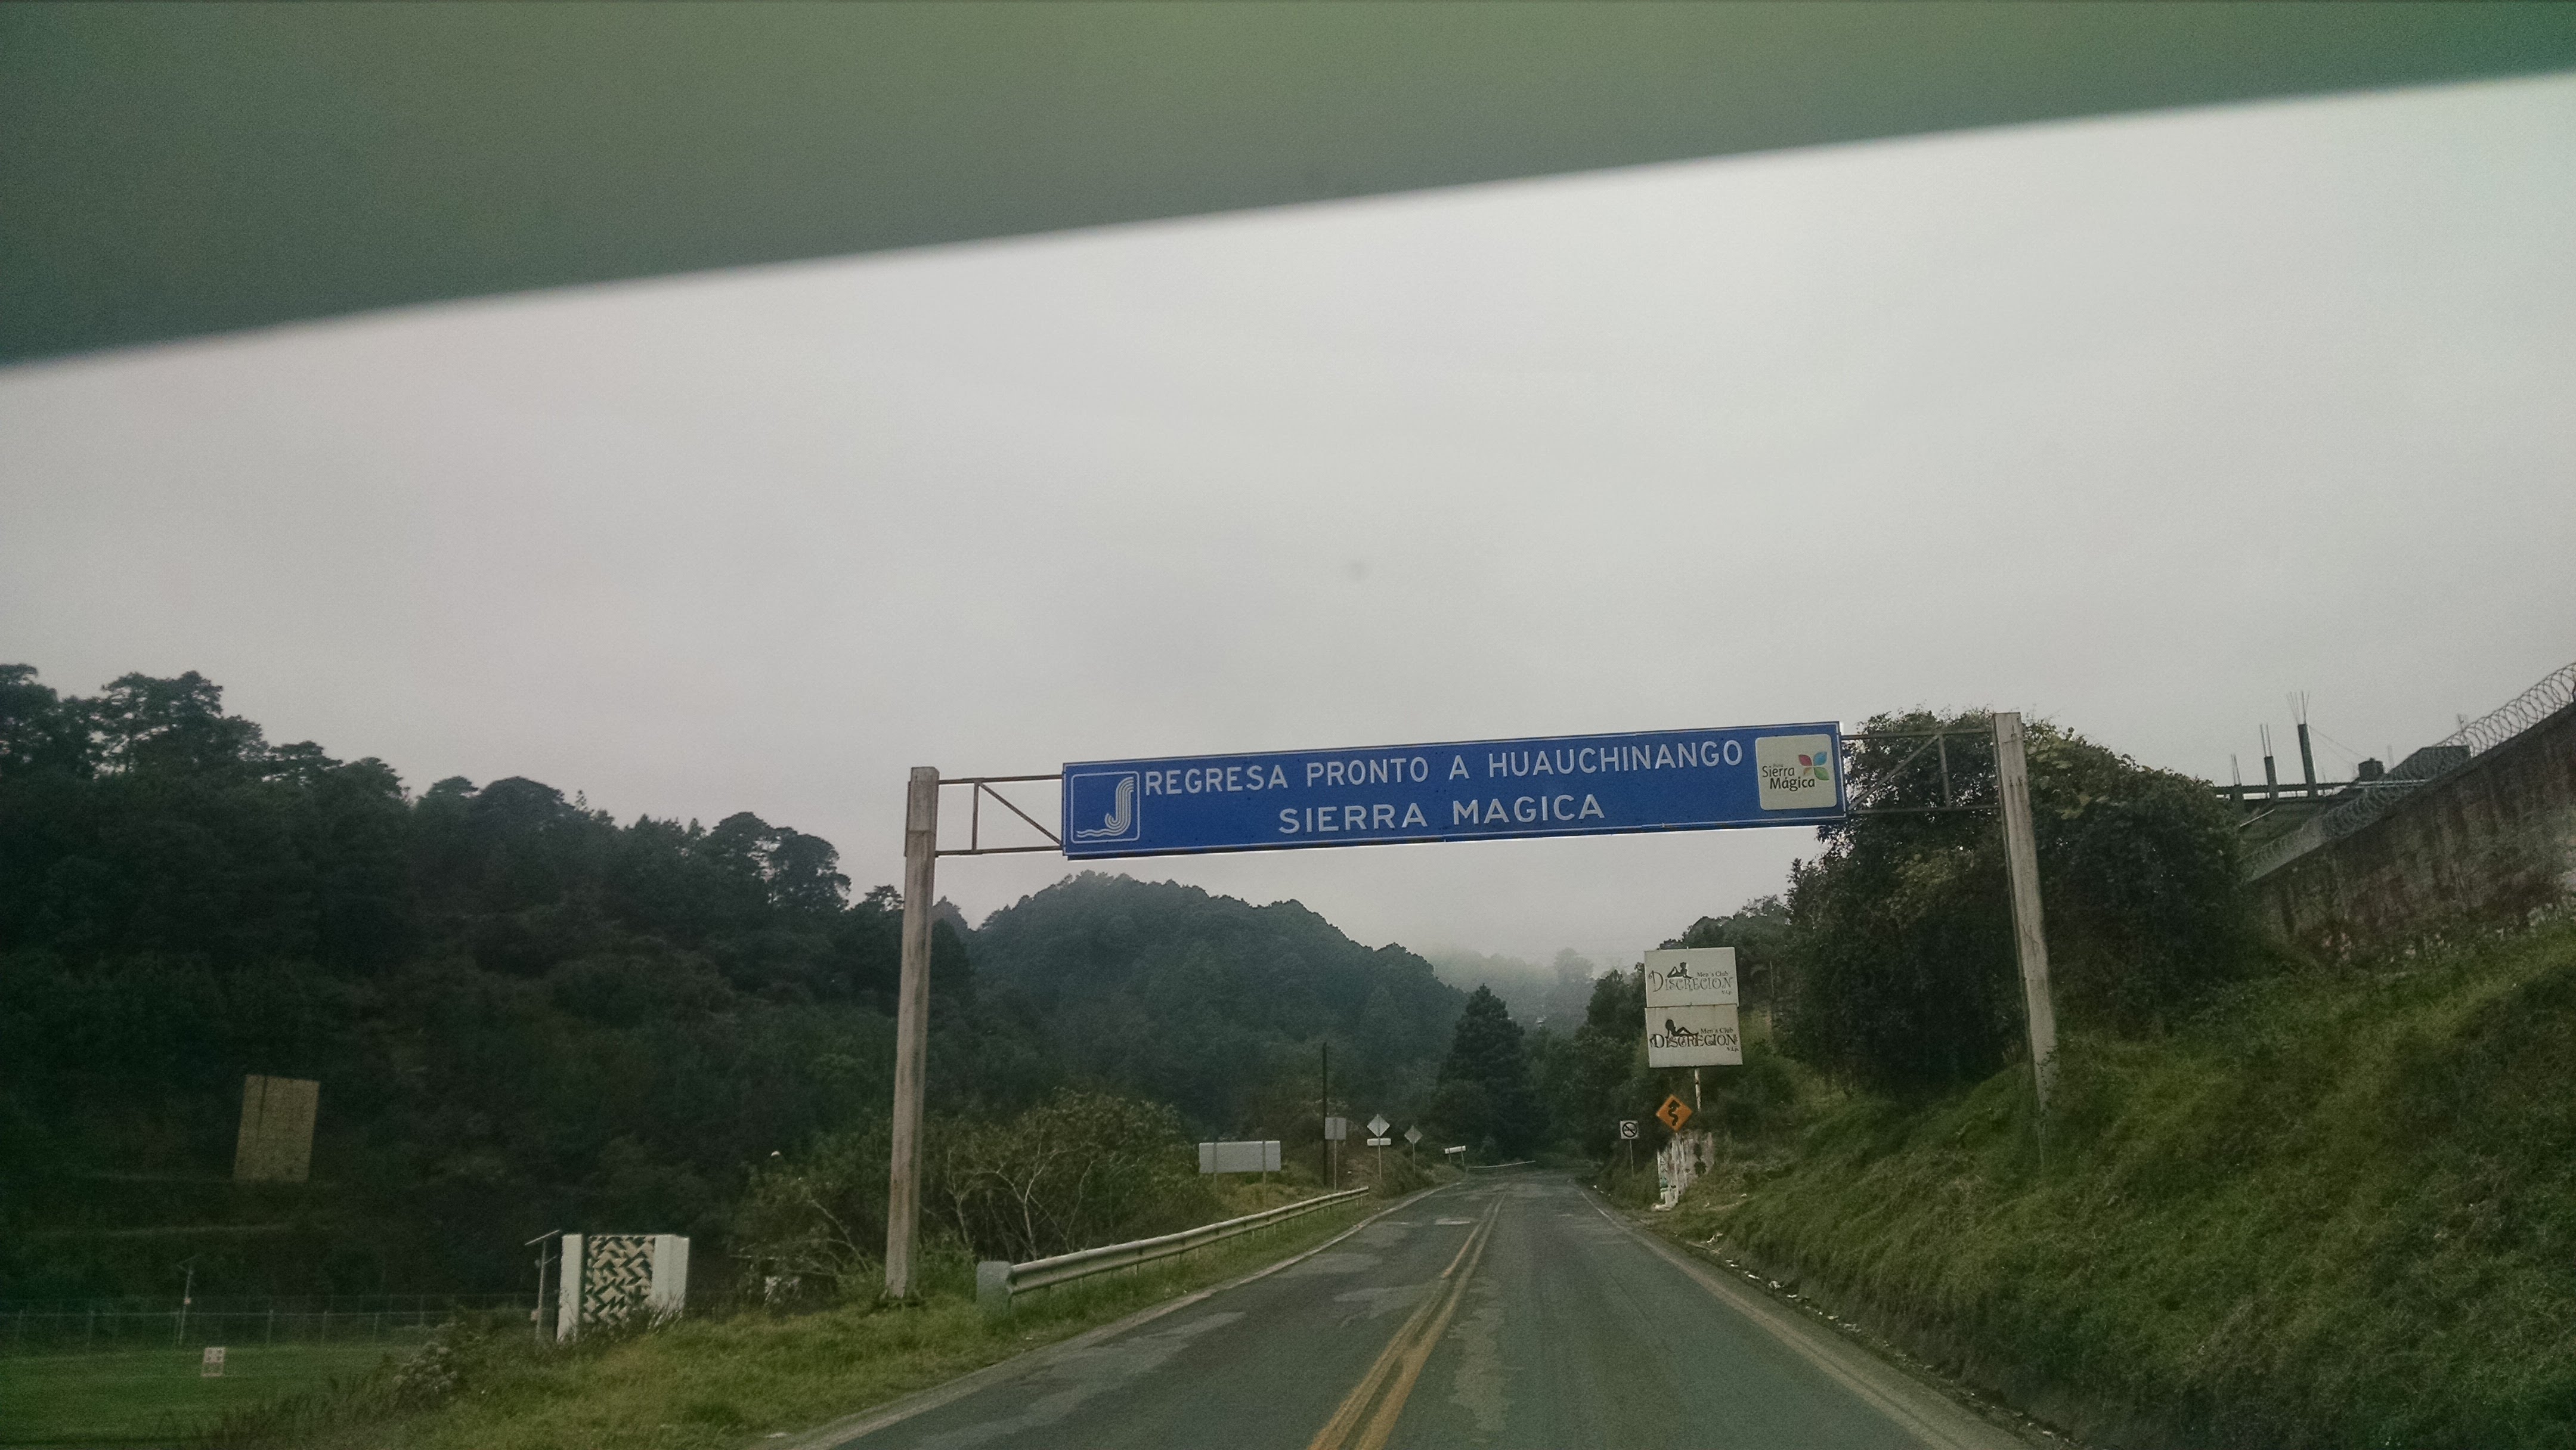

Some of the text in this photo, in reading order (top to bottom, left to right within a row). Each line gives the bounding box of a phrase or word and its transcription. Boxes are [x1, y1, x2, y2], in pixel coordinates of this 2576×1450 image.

[1145, 739, 1744, 796] REGRESA PRONTO A HUAUCHINANGO
[1762, 766, 1795, 777] Sierra
[1770, 776, 1815, 792] Mágica
[1278, 794, 1605, 834] SIERRA MAGICA
